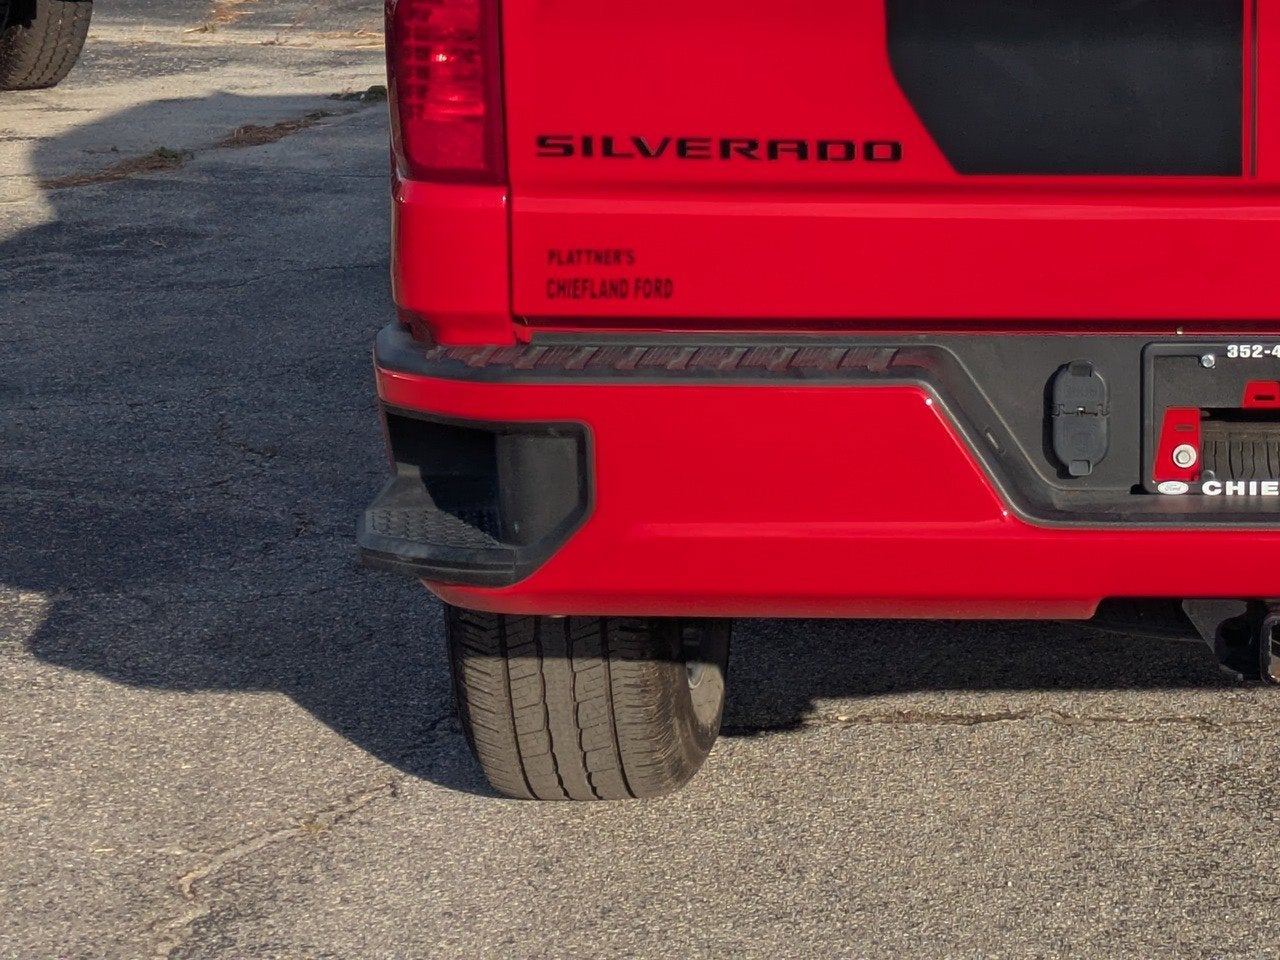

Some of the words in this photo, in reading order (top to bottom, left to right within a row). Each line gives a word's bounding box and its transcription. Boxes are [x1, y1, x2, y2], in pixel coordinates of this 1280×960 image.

[535, 135, 902, 163] SILVERADO
[547, 248, 636, 266] PLATTNER'S
[546, 277, 629, 300] CHIEFLAND
[633, 276, 673, 300] FORD
